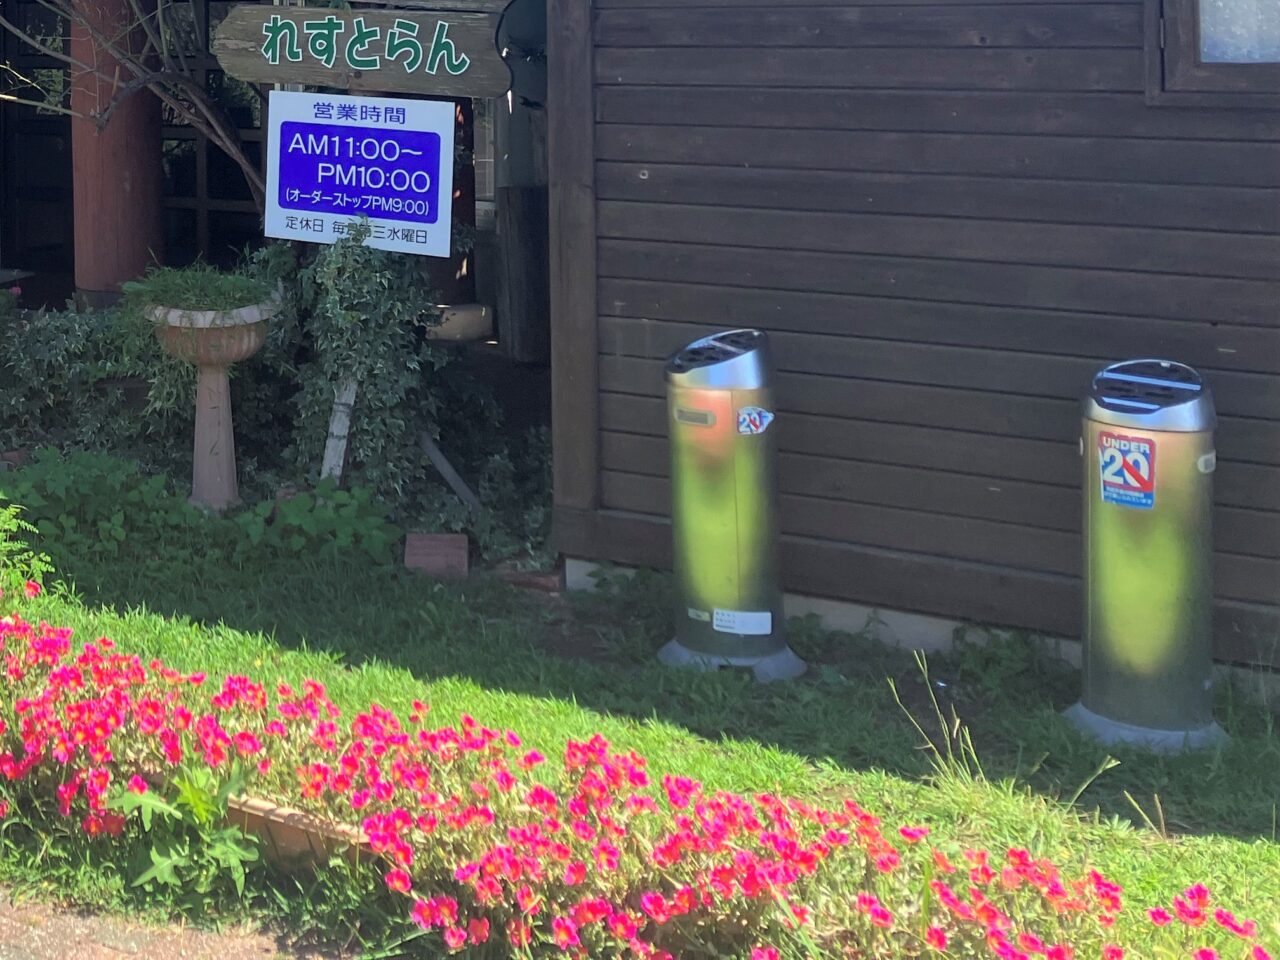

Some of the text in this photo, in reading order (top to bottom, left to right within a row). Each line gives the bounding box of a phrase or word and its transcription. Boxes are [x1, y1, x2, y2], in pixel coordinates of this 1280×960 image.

[261, 15, 470, 75] れすとらん
[313, 102, 406, 125] 営業時間
[318, 163, 430, 193] PM10:00
[285, 216, 324, 233] 定休日
[1103, 436, 1150, 454] UNDER
[1103, 447, 1150, 487] 20
